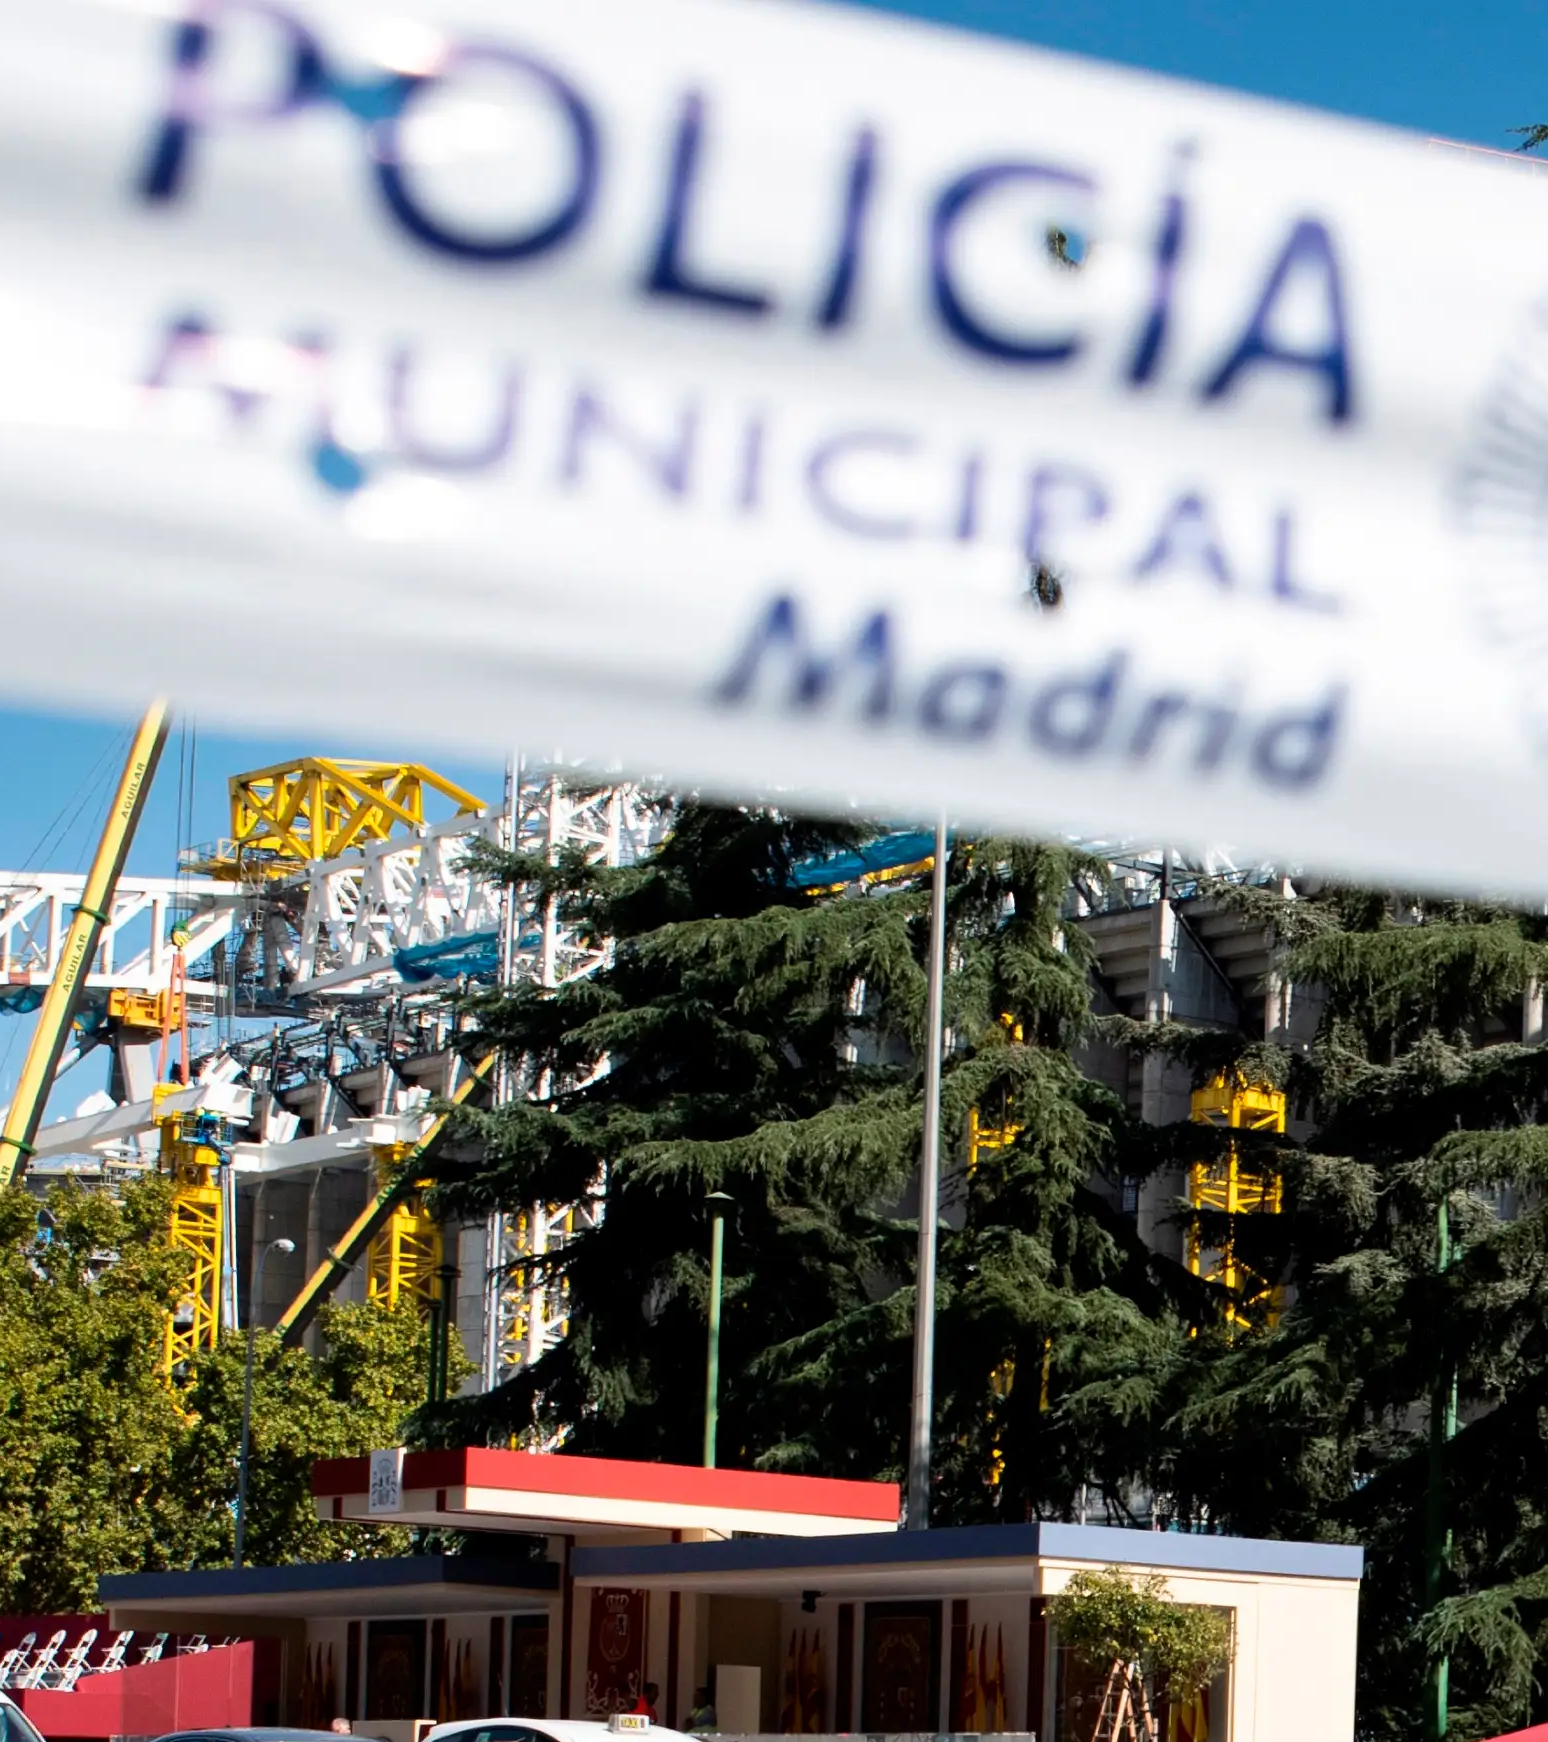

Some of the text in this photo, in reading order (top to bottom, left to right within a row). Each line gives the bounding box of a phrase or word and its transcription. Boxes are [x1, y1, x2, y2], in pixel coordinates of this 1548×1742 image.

[714, 592, 1350, 792] Madrid
[120, 761, 146, 820] AGUILAR
[62, 933, 88, 993] AGUILAR
